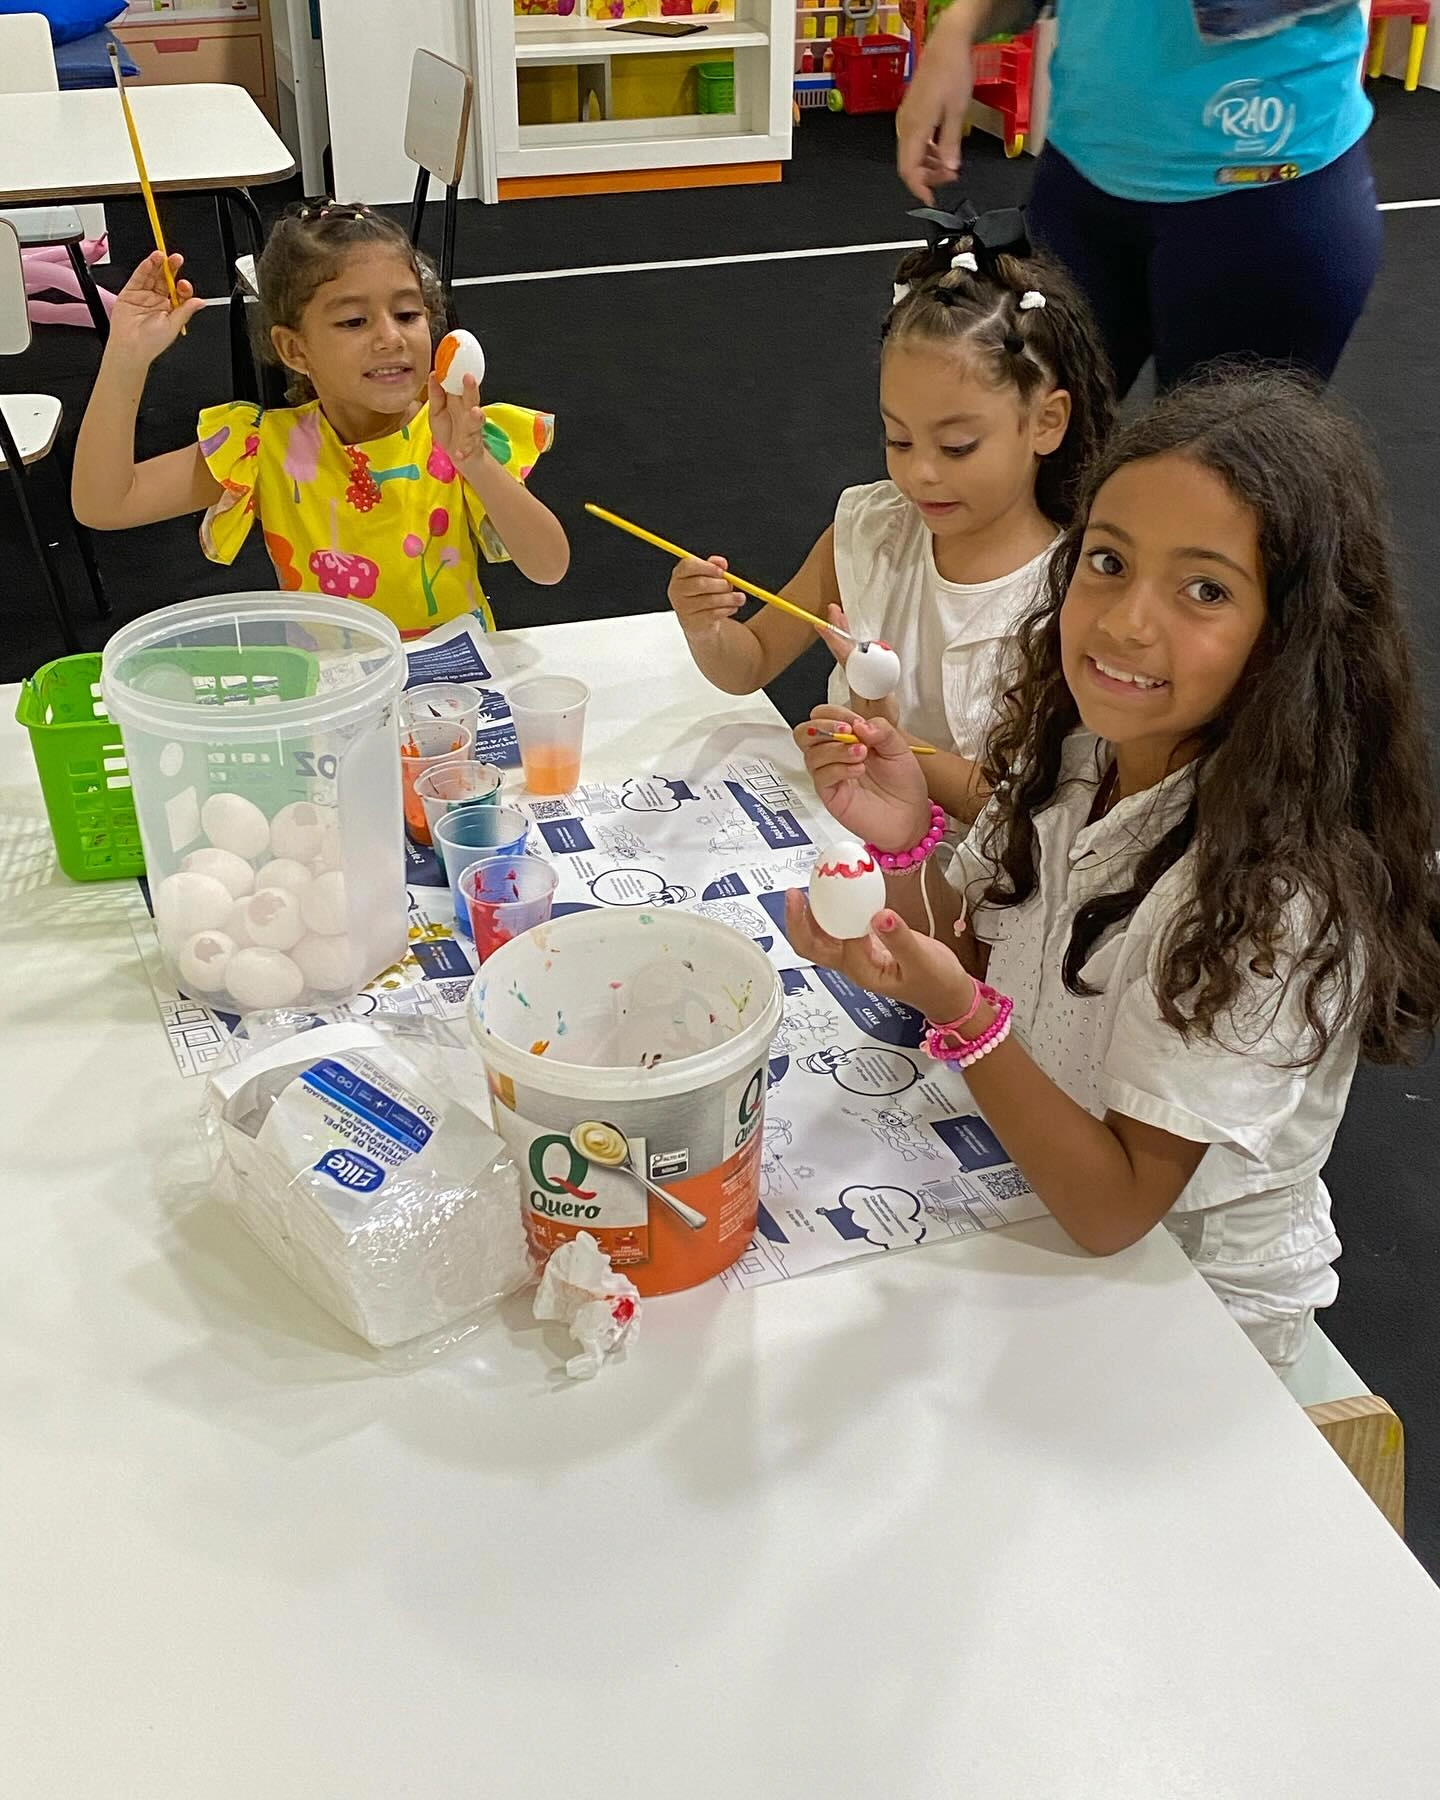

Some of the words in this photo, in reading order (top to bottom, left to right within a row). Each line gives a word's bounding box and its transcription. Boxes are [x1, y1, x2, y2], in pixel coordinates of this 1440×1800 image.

[1213, 96, 1283, 138] RAO
[321, 1114, 353, 1138] PAPEL
[351, 1115, 376, 1134] PAPEL
[416, 1104, 440, 1127] 350
[351, 1135, 366, 1148] DE
[324, 1153, 377, 1189] Elite
[530, 1190, 602, 1220] Quero
